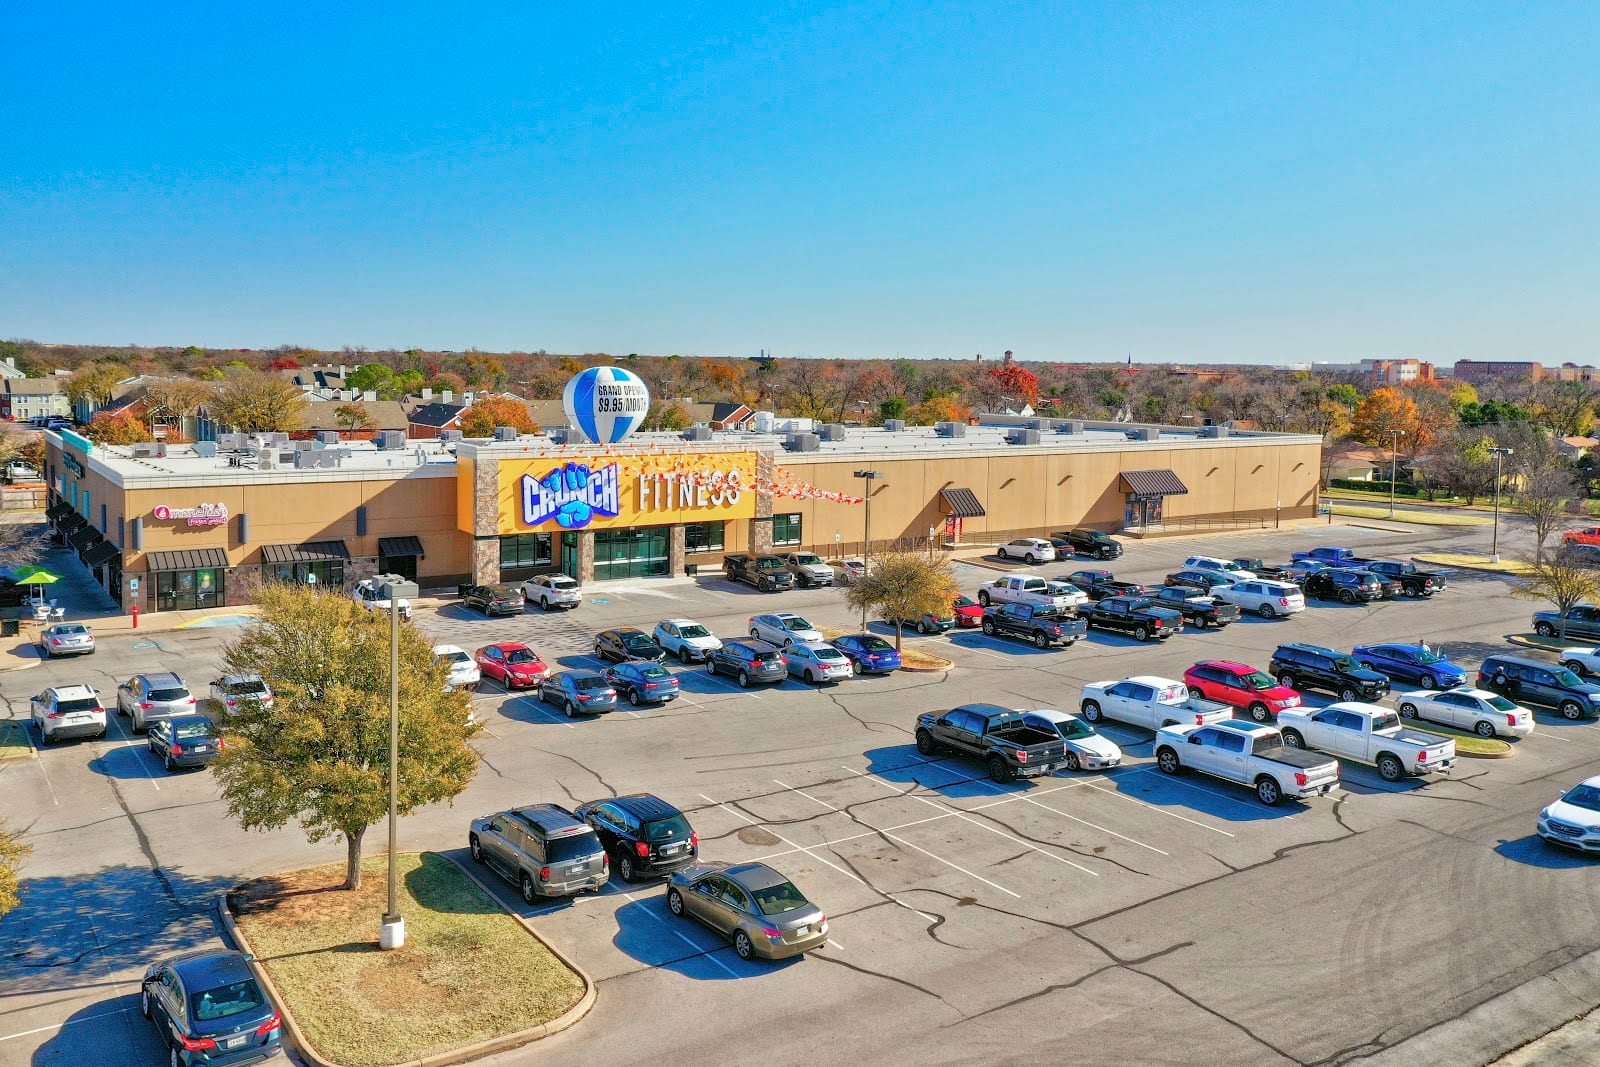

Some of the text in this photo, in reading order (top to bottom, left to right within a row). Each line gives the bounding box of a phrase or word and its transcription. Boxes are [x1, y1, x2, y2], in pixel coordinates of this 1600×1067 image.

[598, 385, 646, 396] GRAND OPEN
[522, 464, 741, 524] CRUNCH FITNESS
